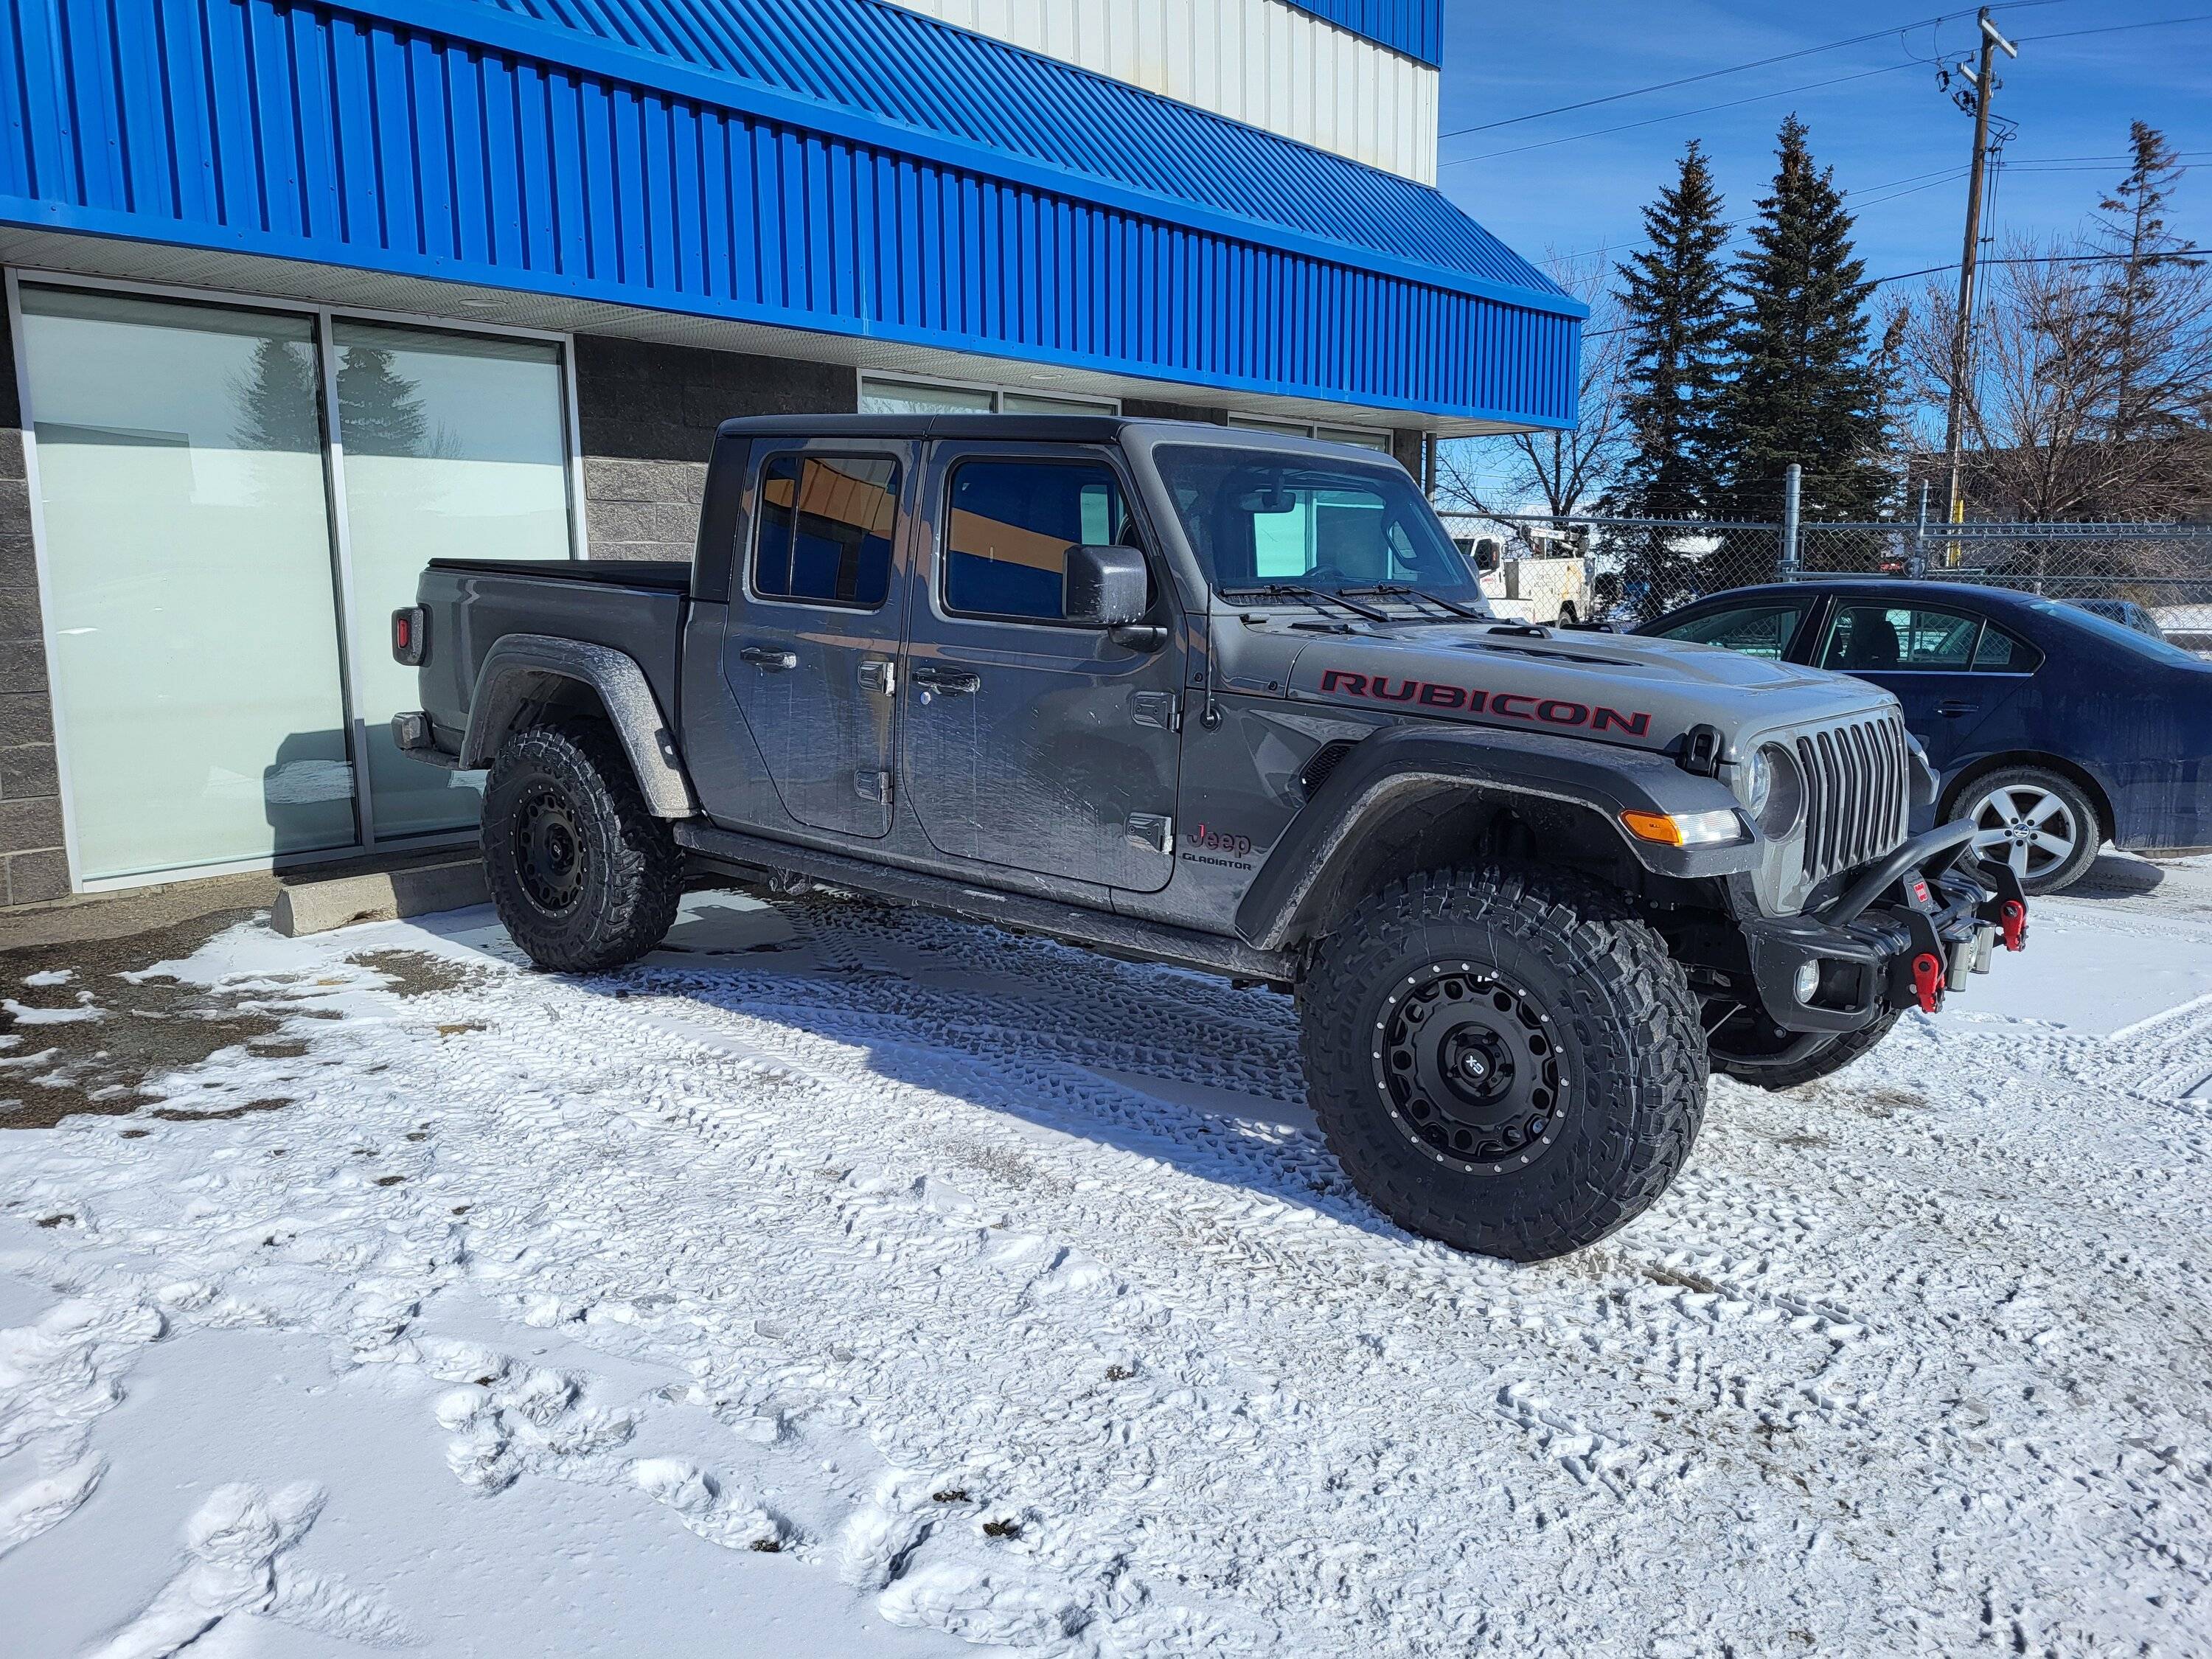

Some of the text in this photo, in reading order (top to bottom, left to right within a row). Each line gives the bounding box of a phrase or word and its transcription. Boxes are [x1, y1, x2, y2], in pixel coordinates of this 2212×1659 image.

[1321, 669, 1652, 737] RUBICON
[1186, 822, 1251, 859] Jeep
[1182, 852, 1252, 871] GLADIATOR
